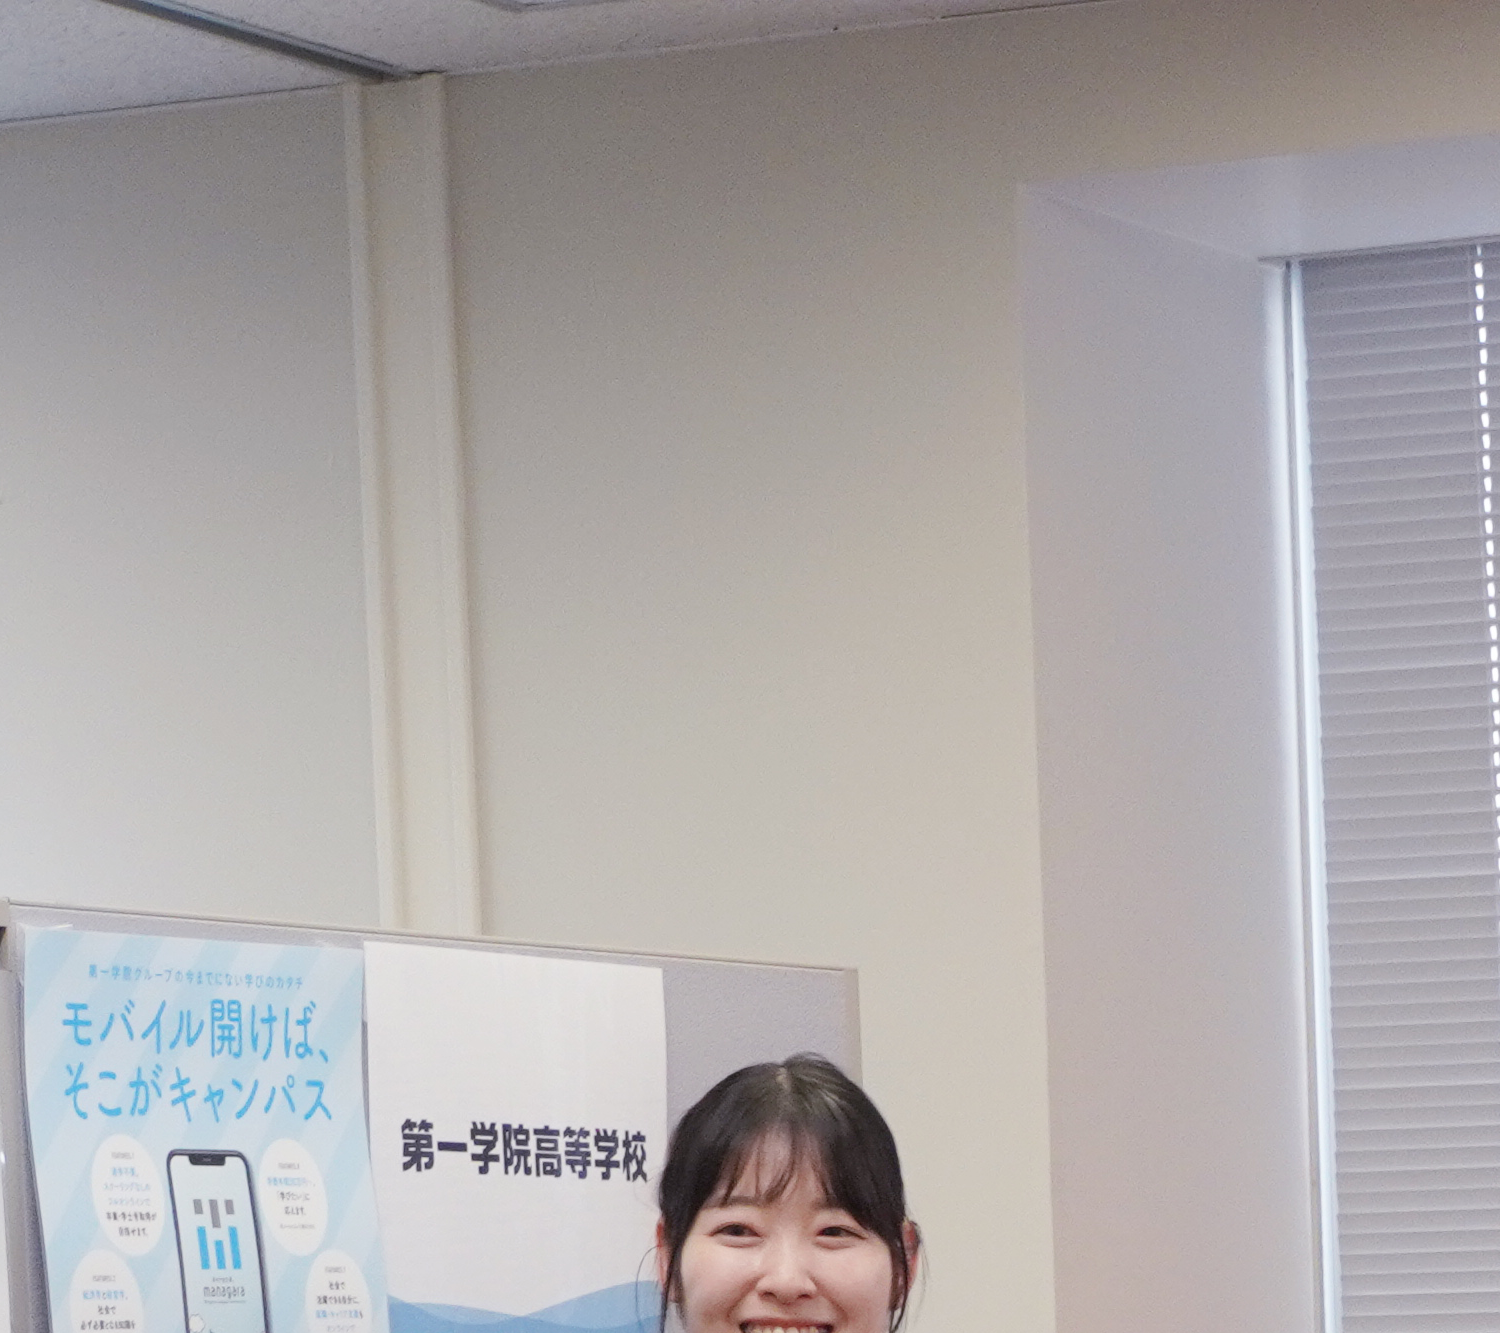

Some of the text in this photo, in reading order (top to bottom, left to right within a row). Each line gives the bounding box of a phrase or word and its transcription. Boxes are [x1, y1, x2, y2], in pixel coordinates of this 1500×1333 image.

[62, 999, 328, 1063] モバイル開けば、
[65, 1063, 332, 1122] そこがキャンパス
[401, 1118, 648, 1182] 第一学院高等学校
